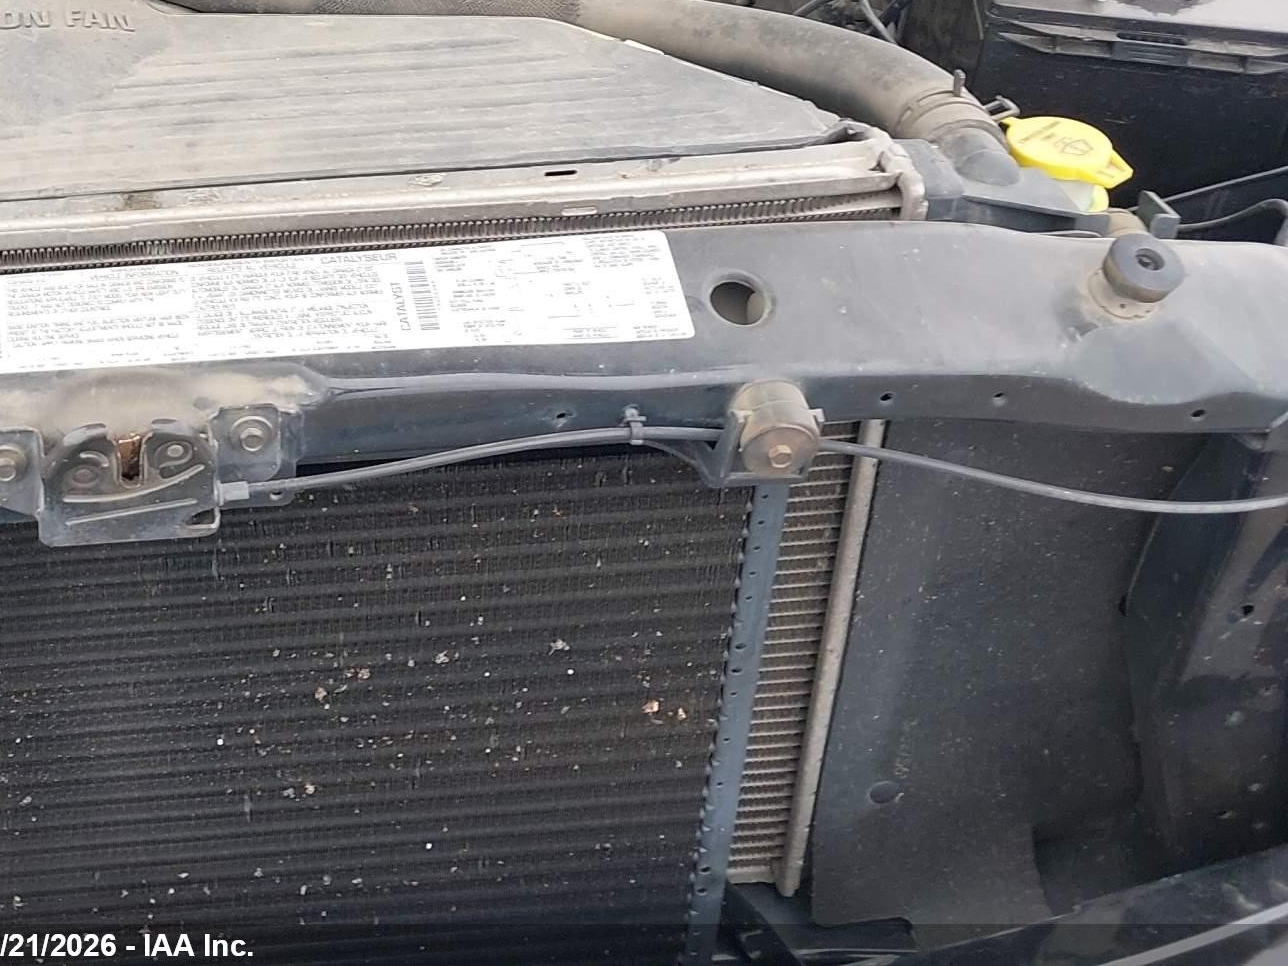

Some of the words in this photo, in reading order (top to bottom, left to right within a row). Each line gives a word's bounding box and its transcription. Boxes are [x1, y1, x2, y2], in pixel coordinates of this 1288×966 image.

[66, 9, 136, 32] FAN
[320, 252, 398, 265] CATALYSEUR
[390, 282, 412, 331] CATALYST
